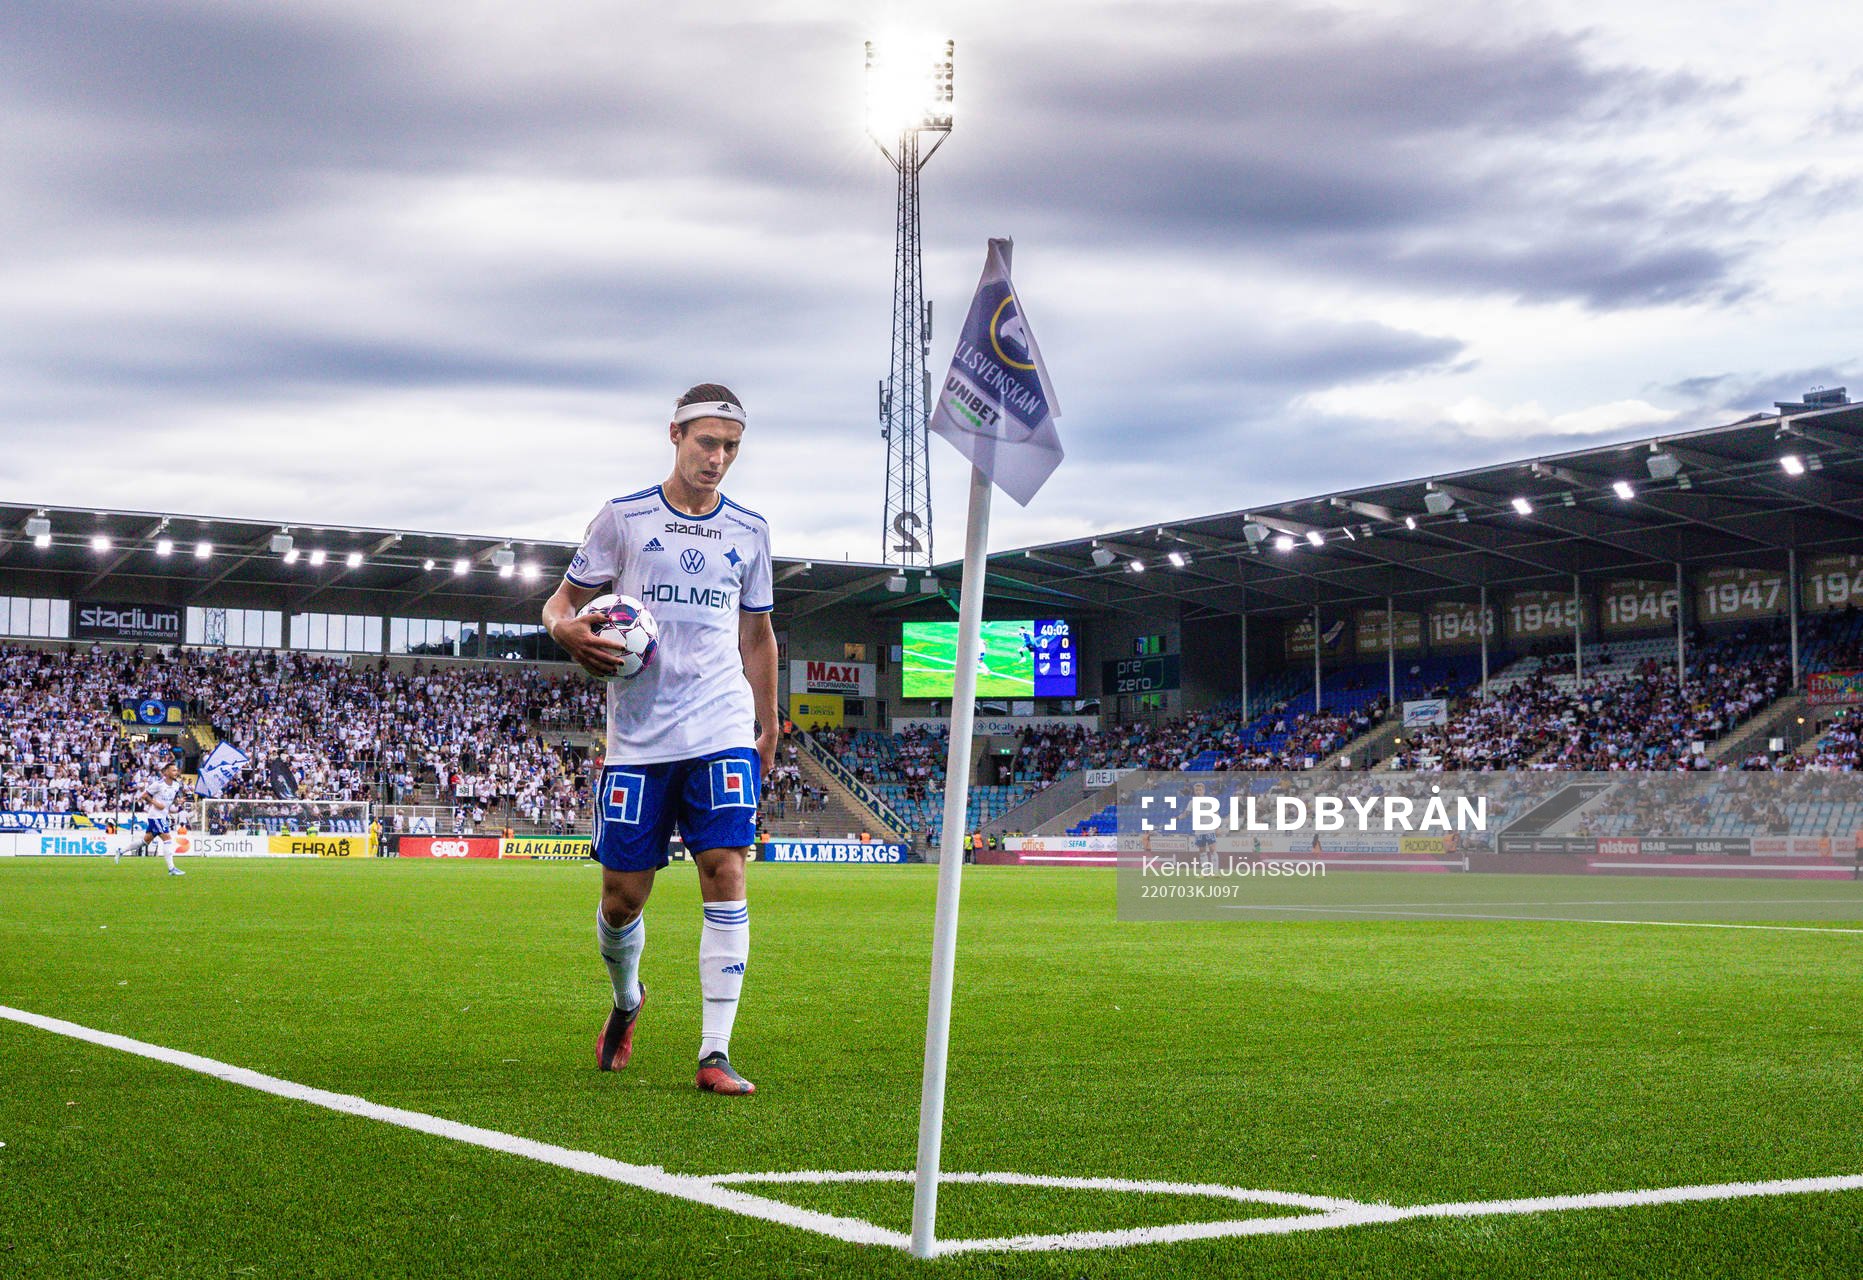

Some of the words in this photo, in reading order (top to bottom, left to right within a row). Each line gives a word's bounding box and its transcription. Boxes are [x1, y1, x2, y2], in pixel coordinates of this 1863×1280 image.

[946, 376, 1001, 426] UNIBET
[664, 521, 722, 540] stadium
[641, 584, 732, 610] HOLMEN
[1704, 578, 1781, 615] 1947
[80, 606, 179, 631] stadium
[1040, 625, 1069, 636] 40:02
[1062, 638, 1069, 648] 0
[807, 661, 860, 683] MAXI
[1117, 660, 1142, 677] pre
[1117, 677, 1152, 692] zero
[41, 836, 108, 854] Flinks
[216, 839, 253, 853] Smith
[505, 840, 591, 855] BLÅKLÄDER
[1068, 840, 1087, 848] SEFAB
[1696, 842, 1721, 851] KSAB
[774, 844, 901, 863] MALMBERGS
